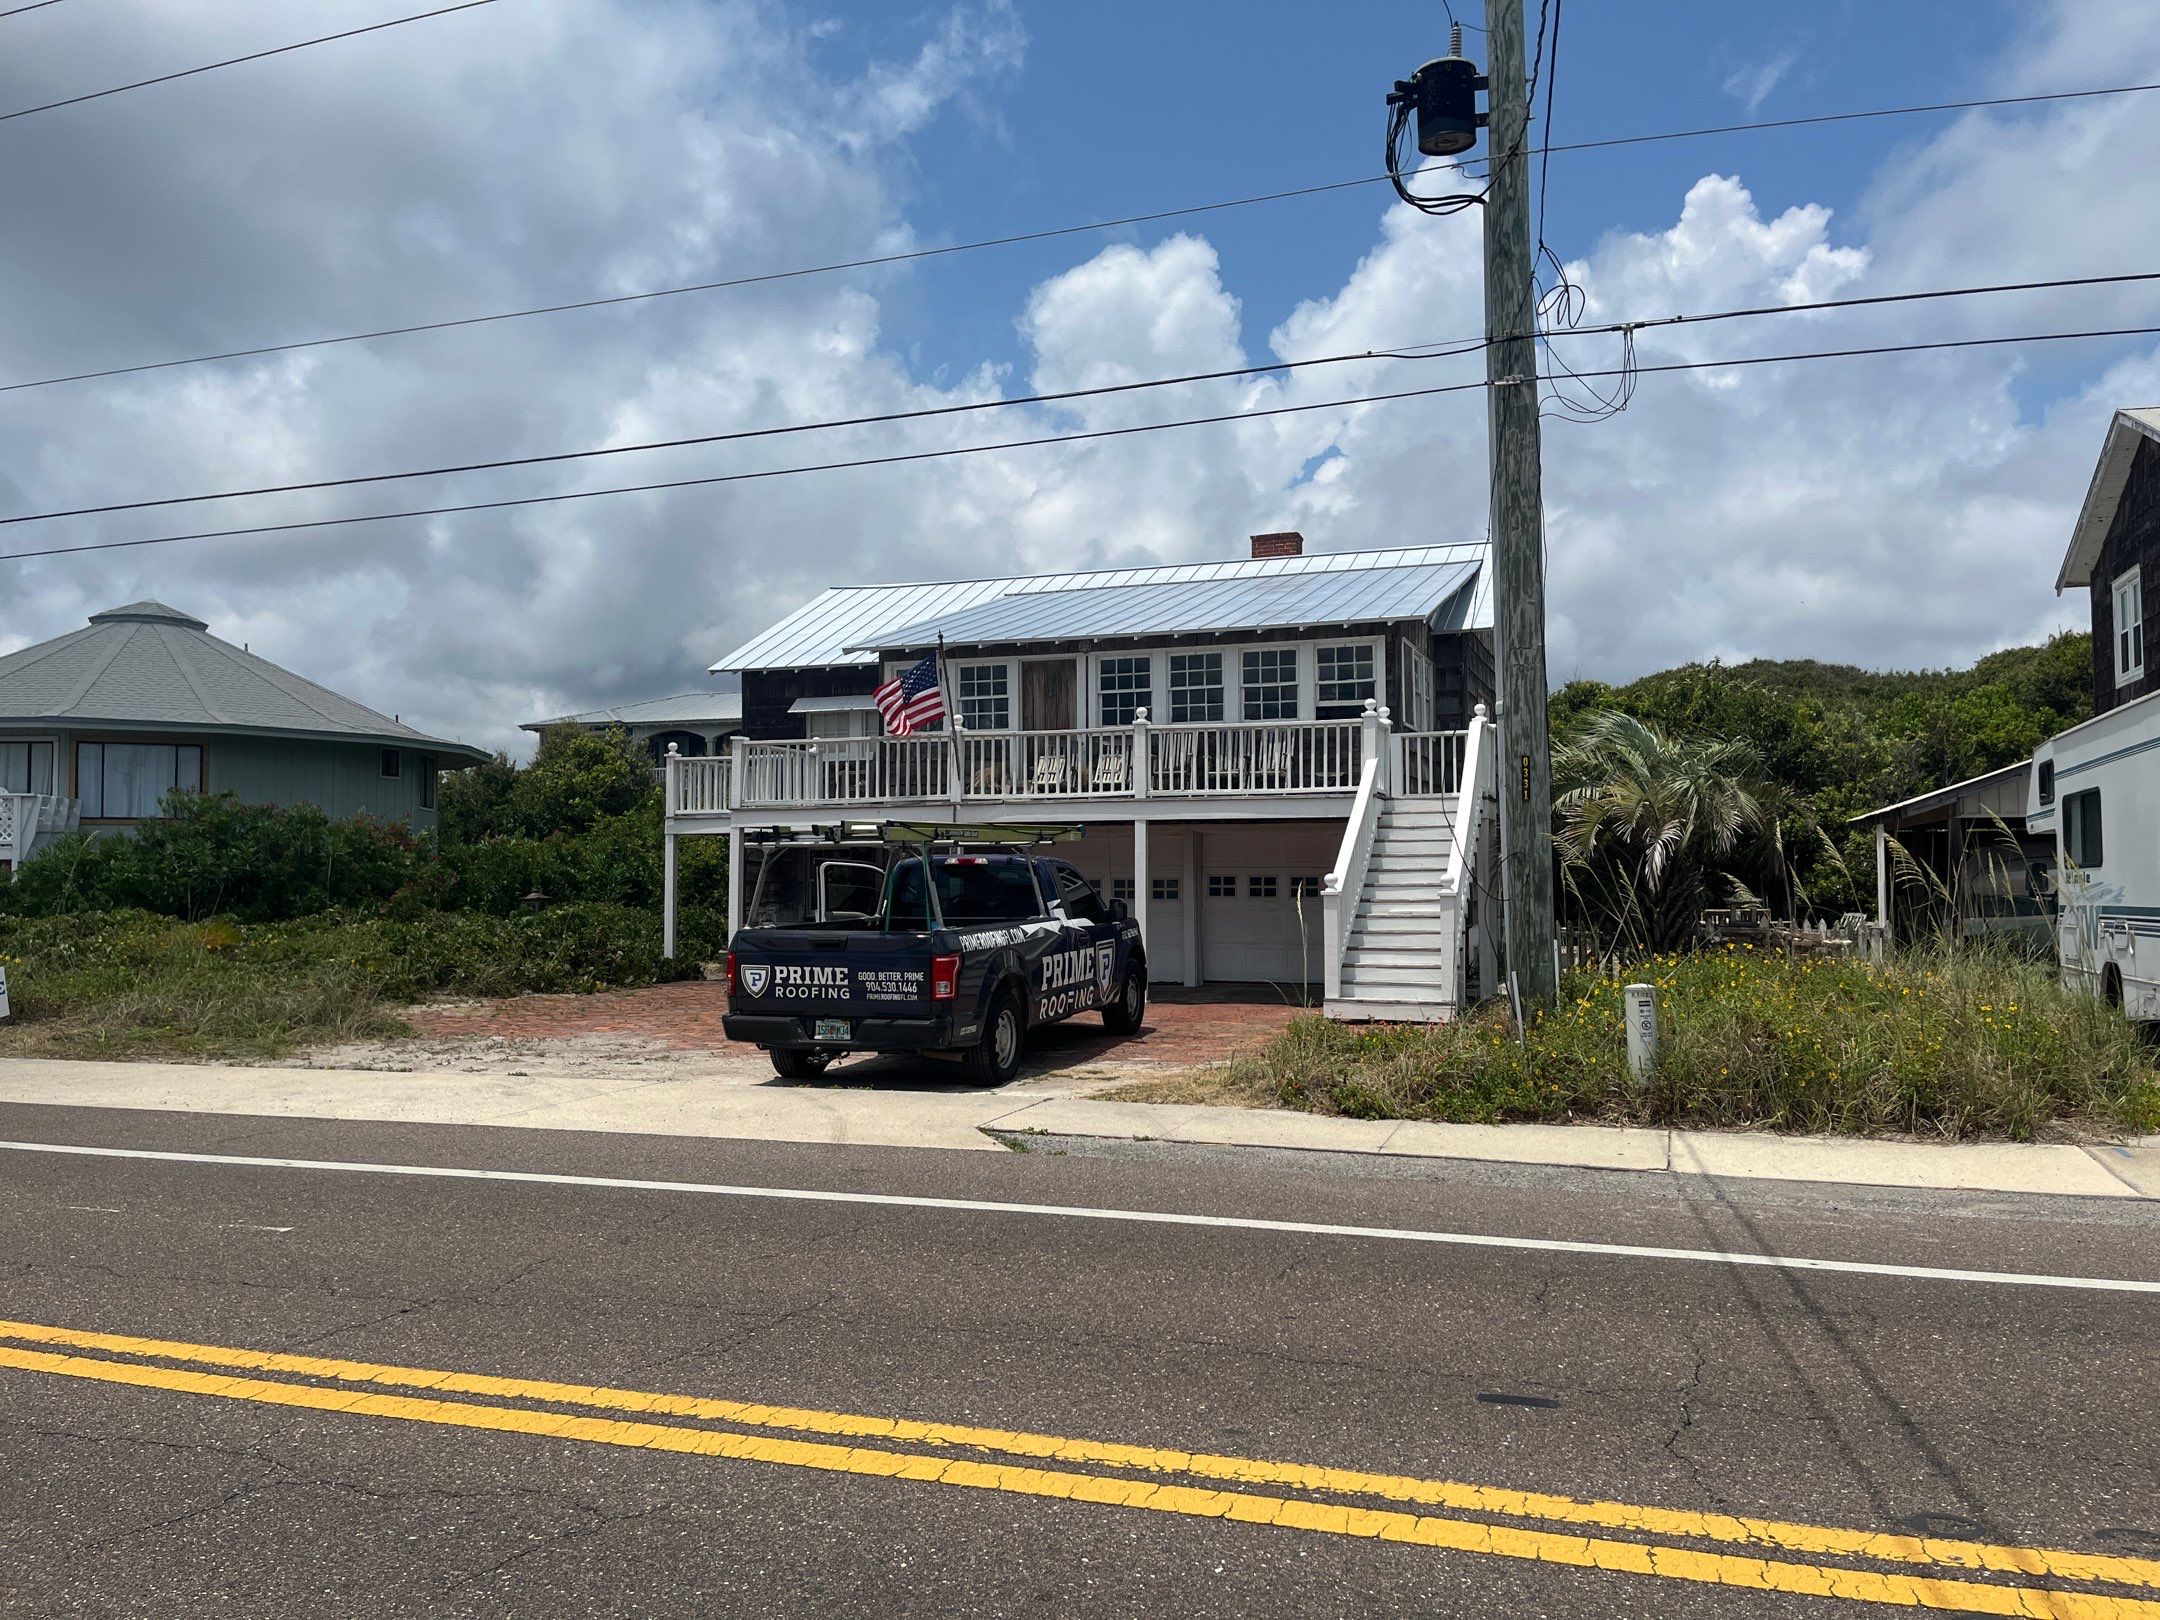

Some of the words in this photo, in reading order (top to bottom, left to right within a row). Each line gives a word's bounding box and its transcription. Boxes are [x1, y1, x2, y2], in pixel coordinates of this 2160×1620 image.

[1522, 756, 1530, 800] 0331
[958, 927, 1026, 952] PRIMEROOFINGFL.COM
[774, 966, 849, 985] PRIME
[904, 972, 924, 981] PRIME
[1040, 947, 1095, 992] PRIME
[775, 986, 850, 999] ROOFING
[865, 981, 918, 993] 904.530.1446
[1039, 985, 1095, 1020] ROOFING
